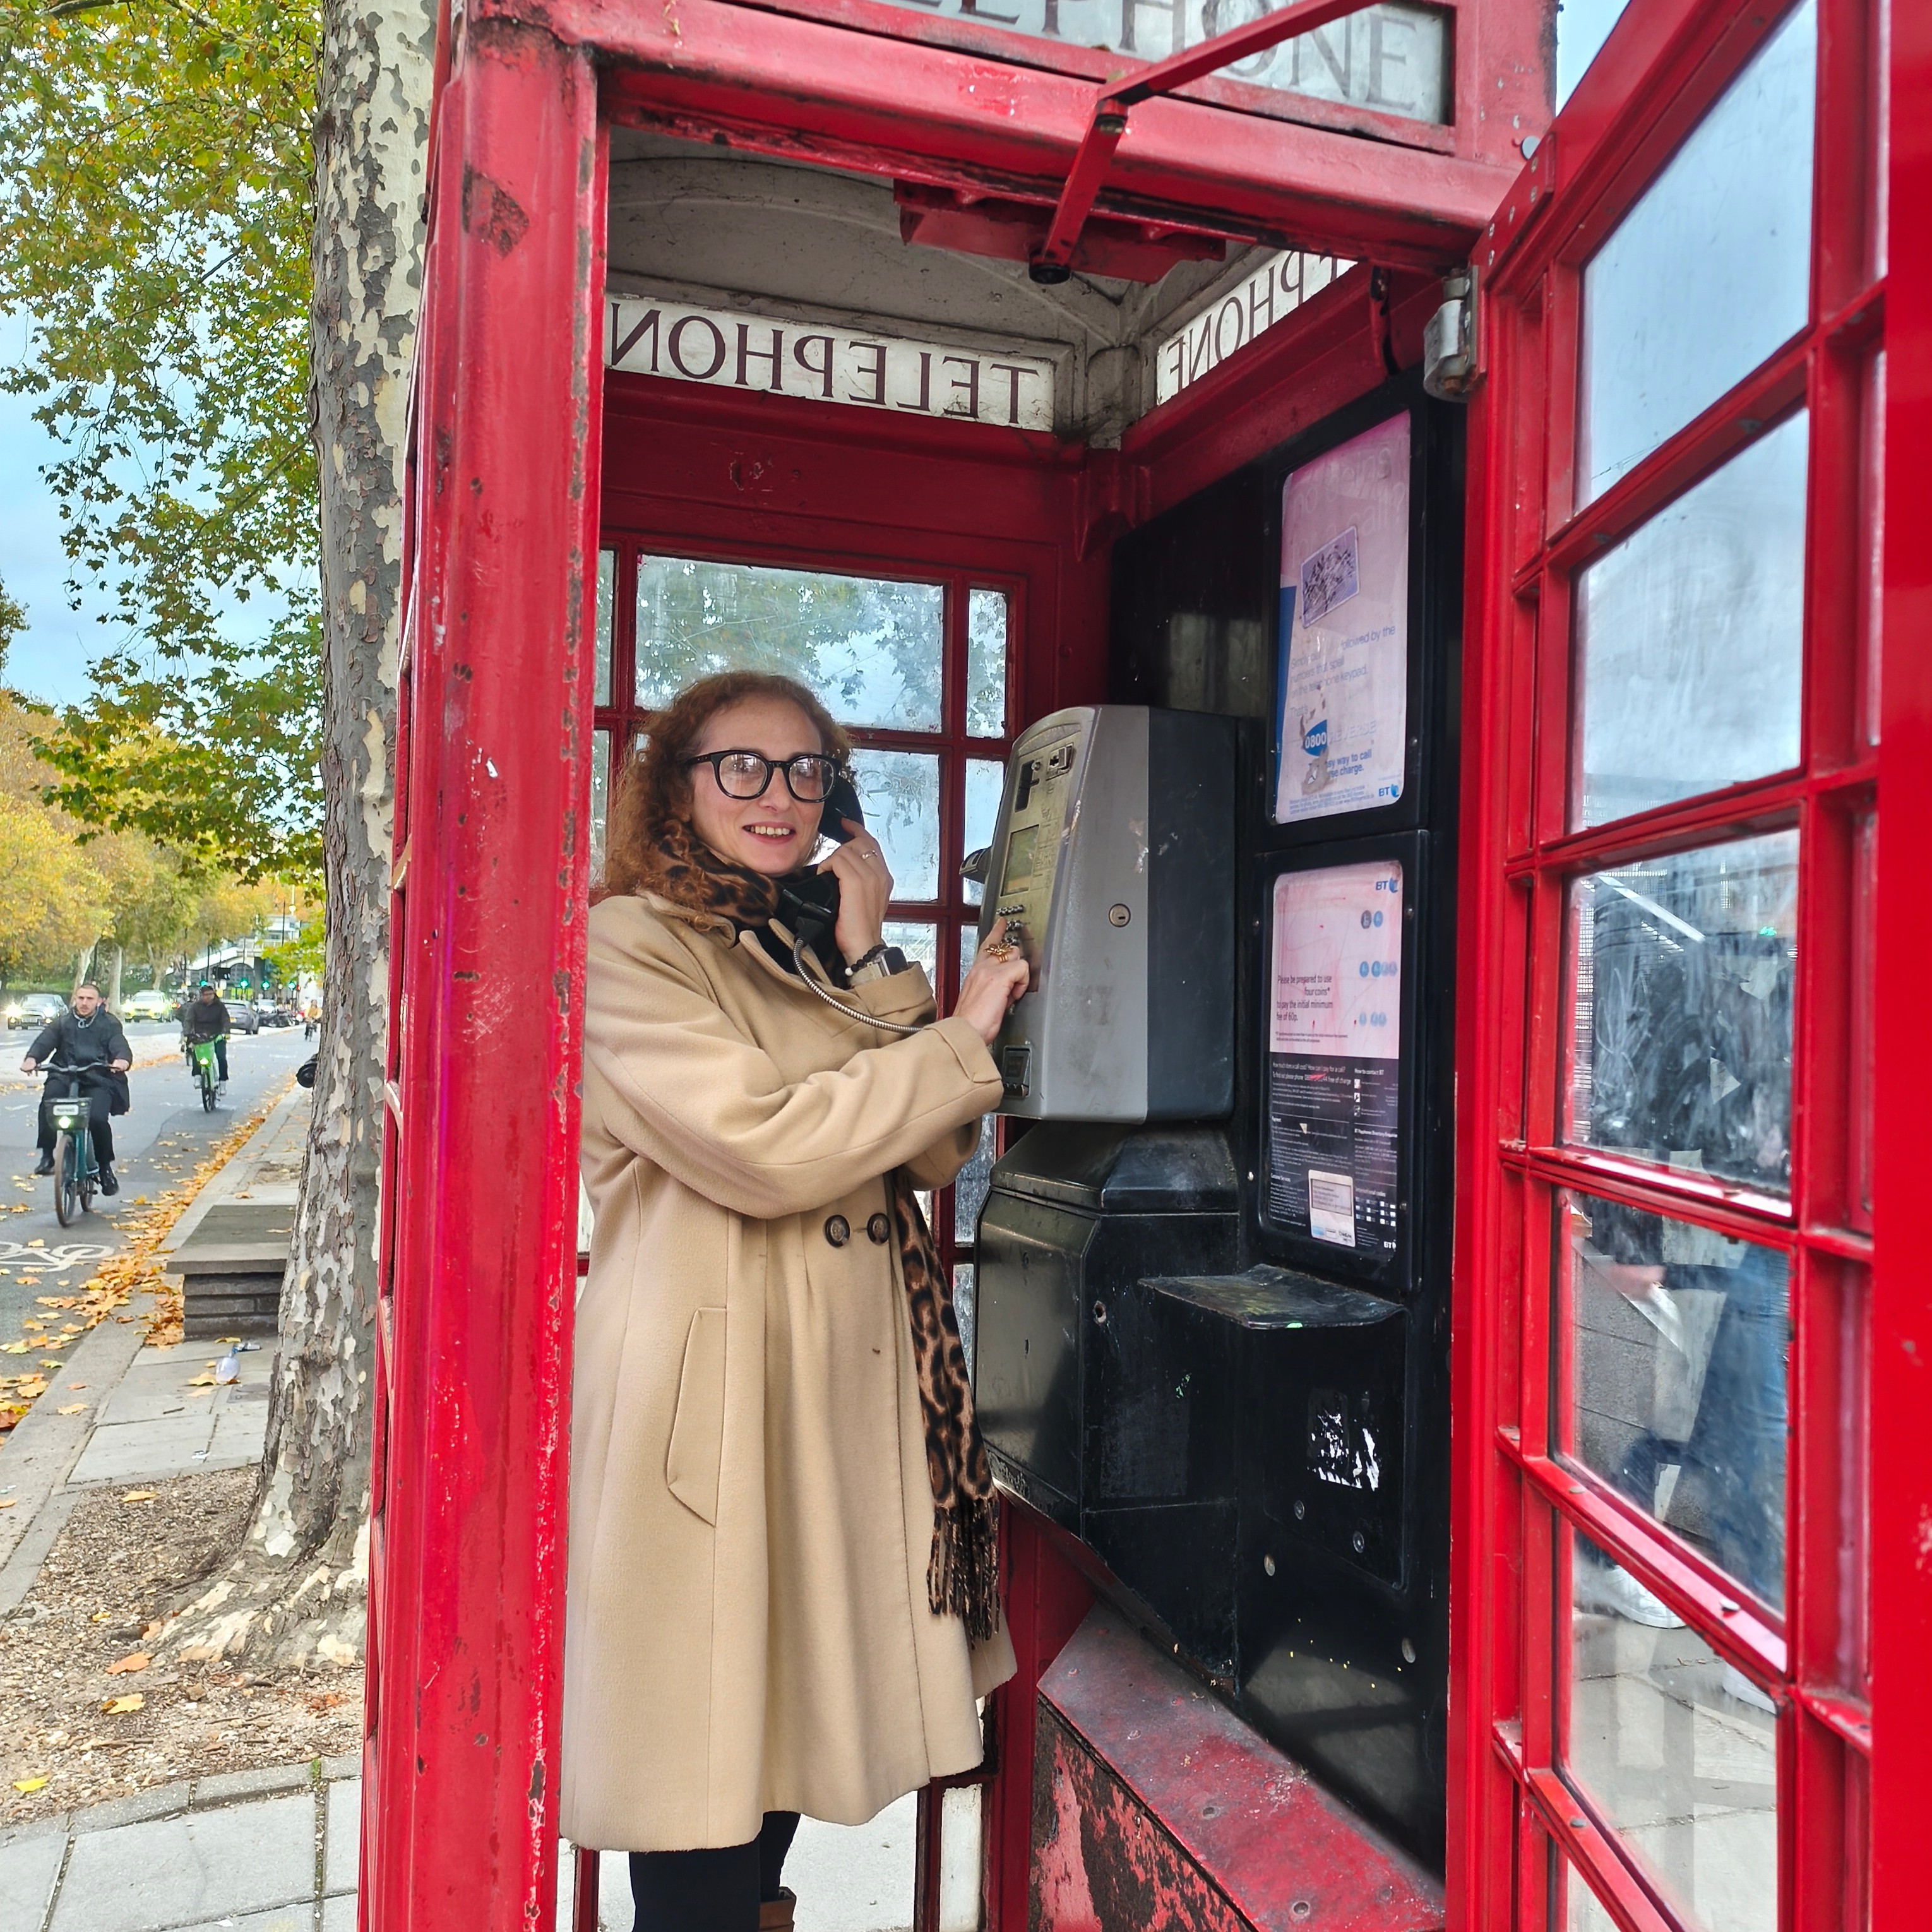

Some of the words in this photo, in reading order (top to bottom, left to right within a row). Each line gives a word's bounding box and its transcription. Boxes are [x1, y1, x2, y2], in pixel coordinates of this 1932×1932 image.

[1371, 630, 1381, 642] by
[1383, 626, 1396, 637] the
[1340, 664, 1368, 682] keypad.
[1305, 732, 1327, 749] 0800
[1337, 756, 1350, 766] way
[1351, 754, 1358, 762] to
[1359, 749, 1372, 760] call
[1340, 764, 1364, 776] charge.
[1378, 787, 1390, 797] BT
[1376, 881, 1388, 891] BT
[1277, 974, 1289, 984] Please
[1291, 975, 1296, 983] be
[1296, 974, 1316, 985] prepared
[1304, 986, 1315, 996] four
[1297, 999, 1309, 1008] initial
[1311, 999, 1333, 1008] minimum
[1283, 1011, 1287, 1021] of
[1289, 1011, 1298, 1022] 60p.
